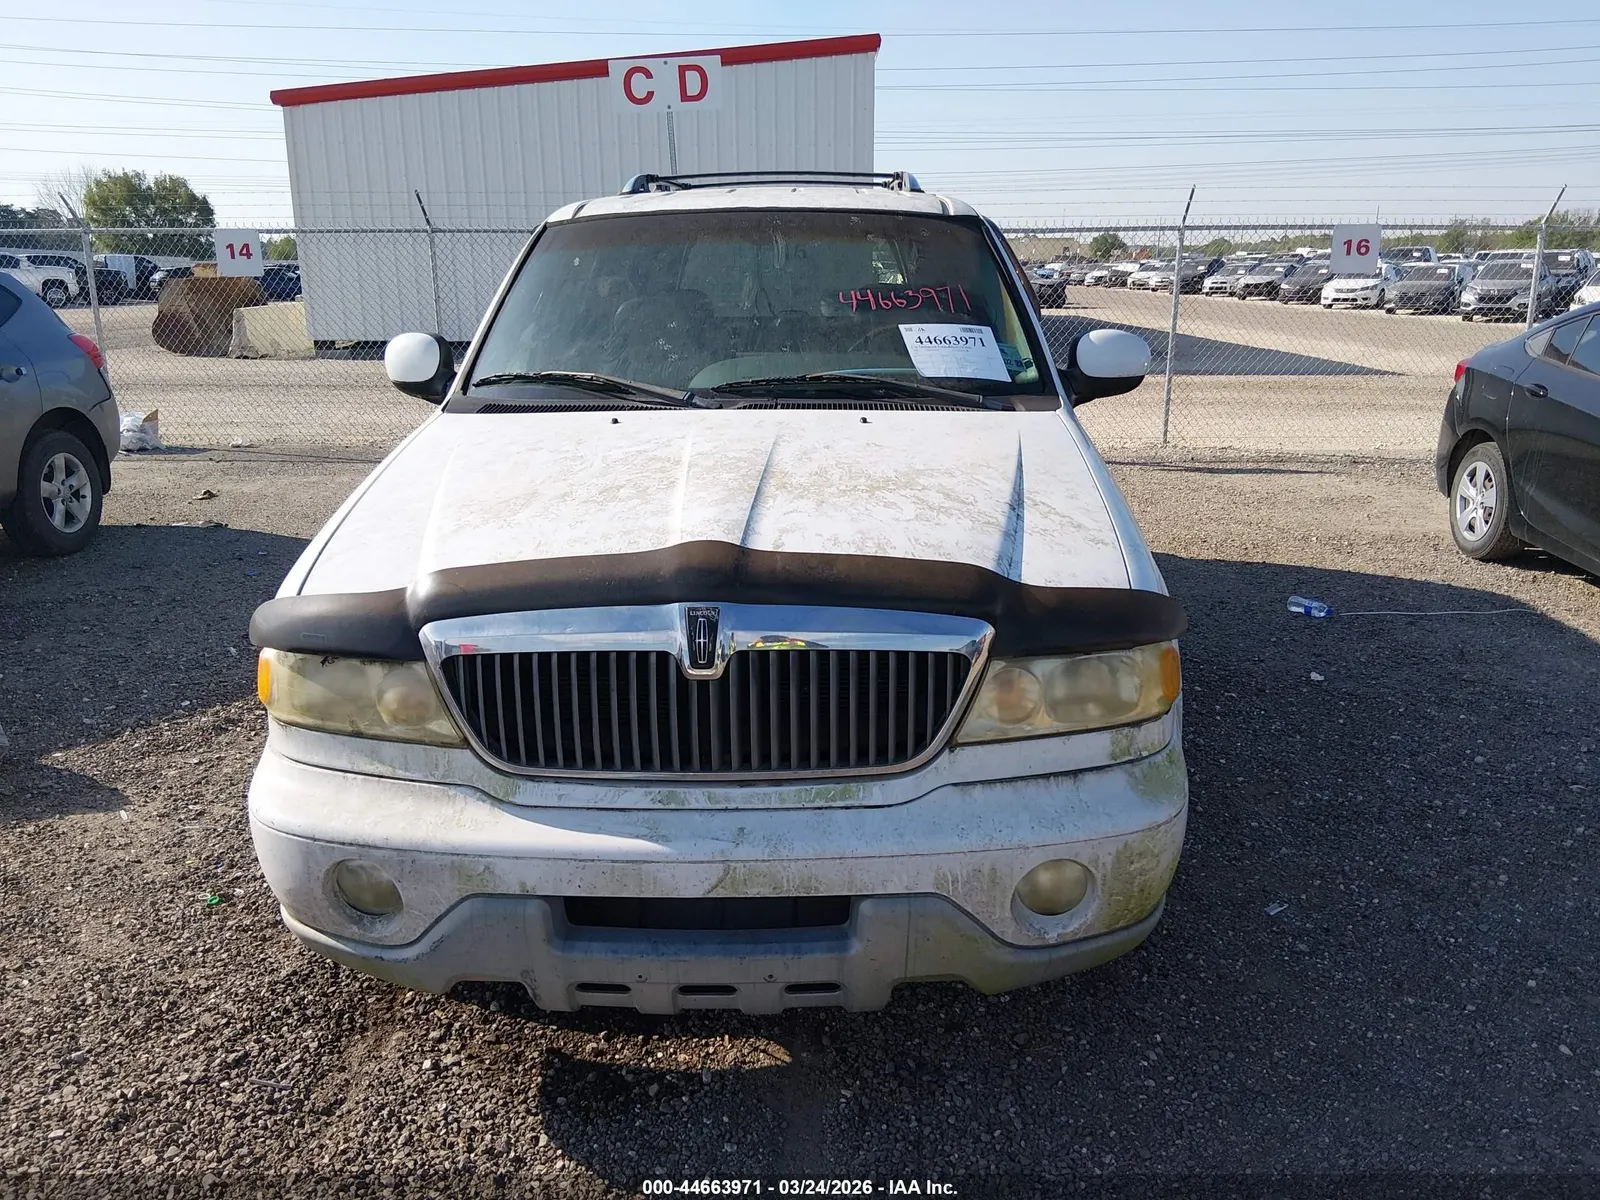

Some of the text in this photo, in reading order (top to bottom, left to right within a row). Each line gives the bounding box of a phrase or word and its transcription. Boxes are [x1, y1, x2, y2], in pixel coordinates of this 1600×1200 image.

[623, 64, 709, 105] C D
[225, 243, 253, 260] 14
[1343, 238, 1370, 256] 16
[838, 284, 972, 313] 44663971
[915, 335, 987, 347] 44663971
